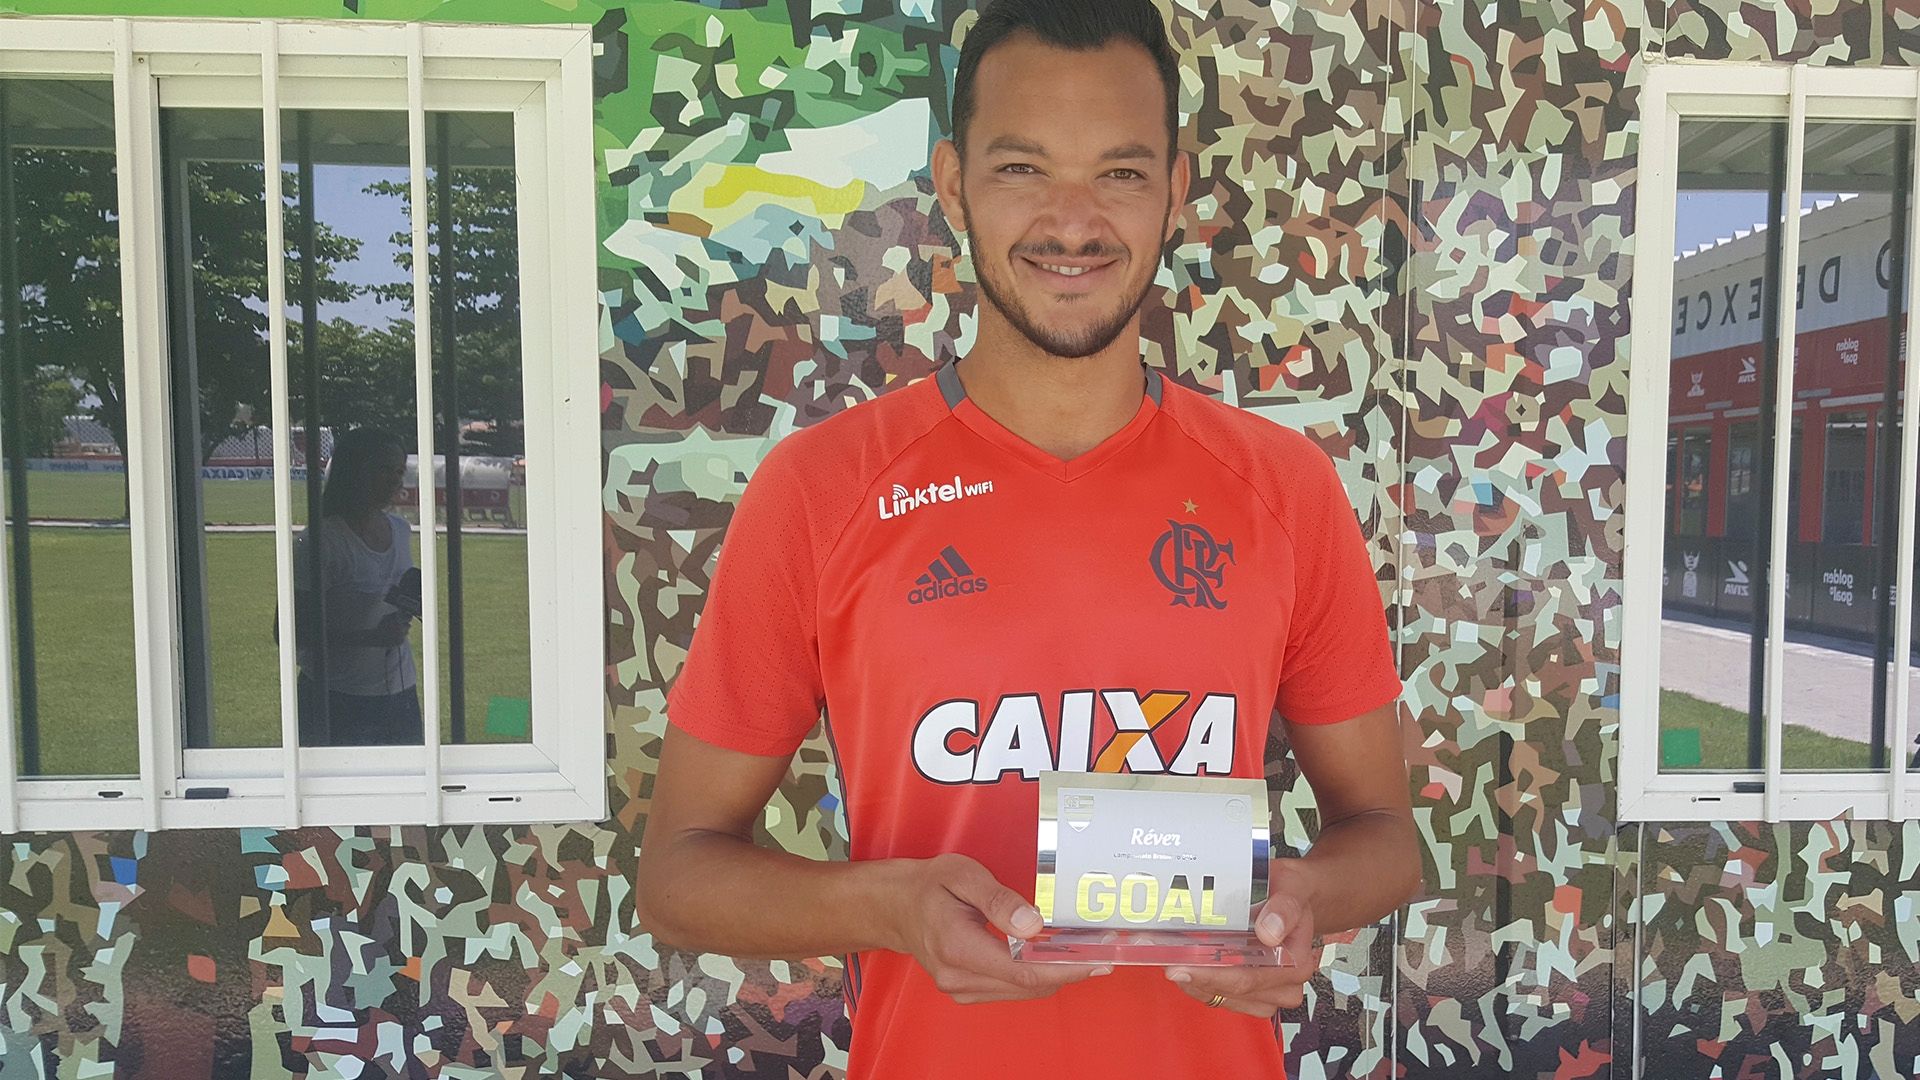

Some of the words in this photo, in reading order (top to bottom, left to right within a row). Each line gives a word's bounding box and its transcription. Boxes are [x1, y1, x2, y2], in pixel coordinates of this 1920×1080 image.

[878, 475, 963, 520] Linktel
[907, 576, 989, 605] adidas
[911, 688, 1237, 785] CAIXA
[1130, 827, 1182, 847] Réver
[1075, 870, 1228, 926] GOAL
